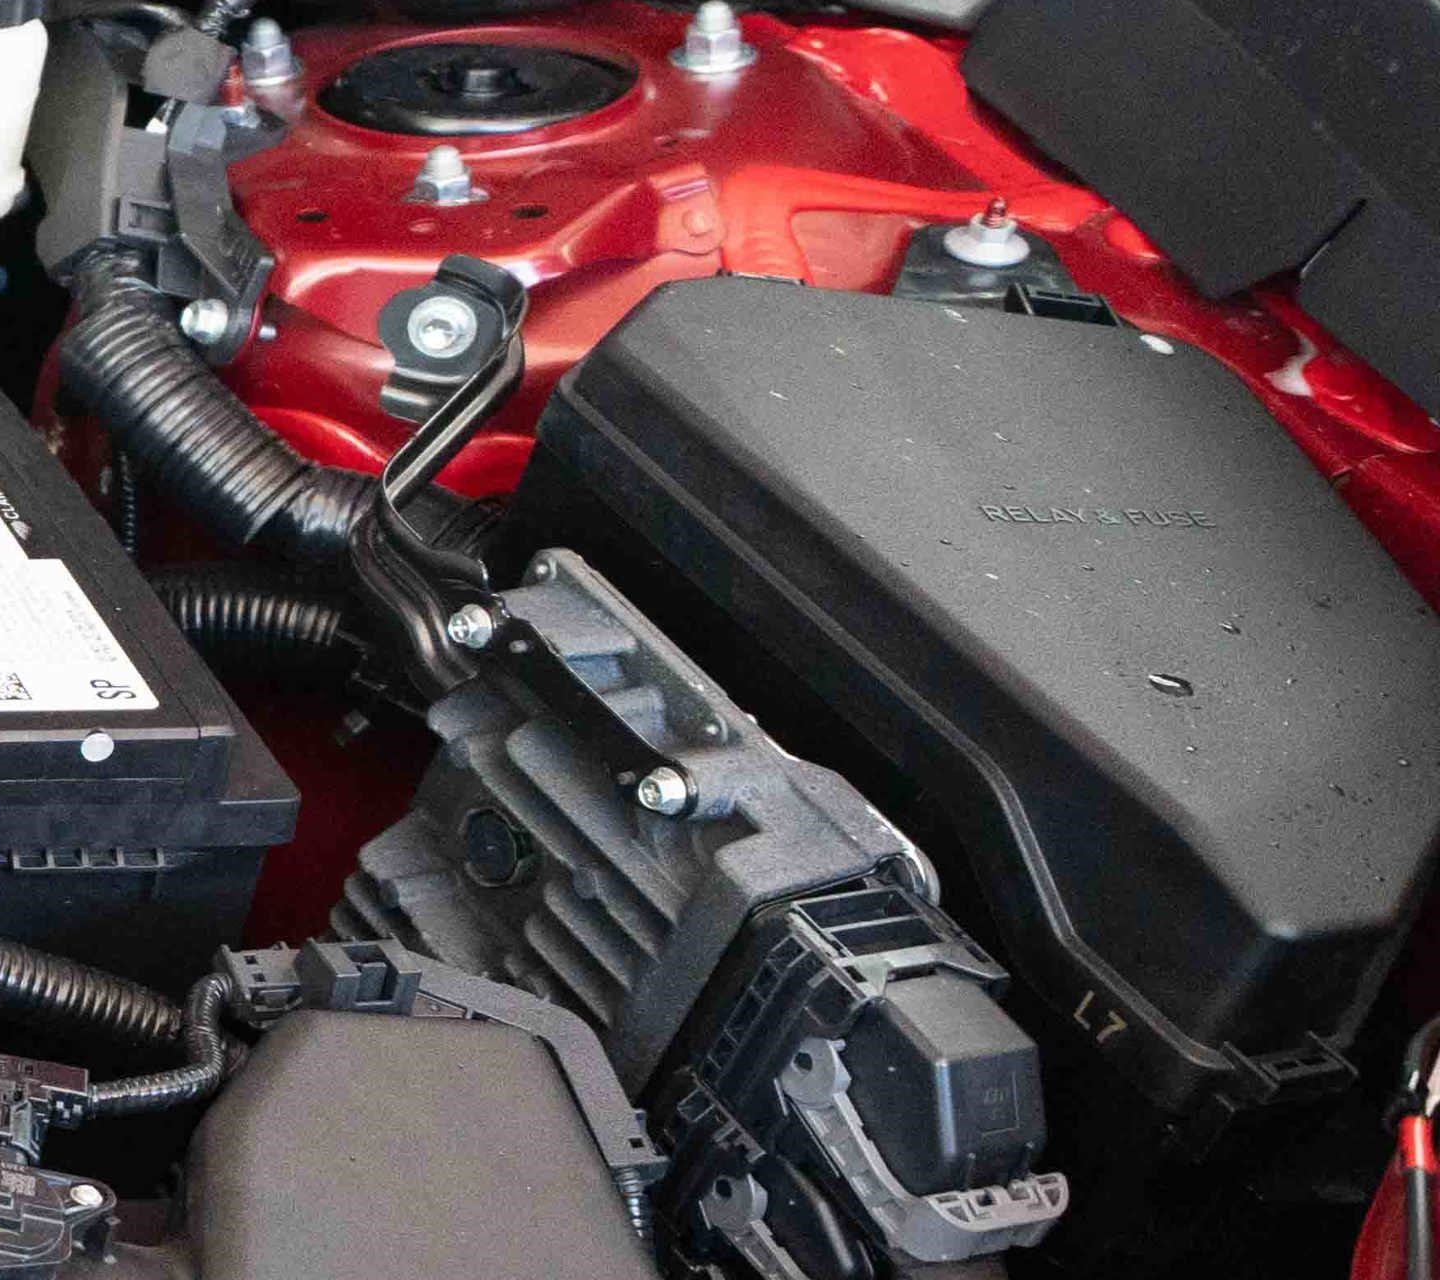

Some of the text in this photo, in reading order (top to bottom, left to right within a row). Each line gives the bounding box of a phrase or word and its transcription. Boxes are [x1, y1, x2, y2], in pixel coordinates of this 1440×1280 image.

[979, 504, 1216, 528] RELAY & FUSE
[90, 678, 137, 700] SP
[1073, 989, 1128, 1044] L7
